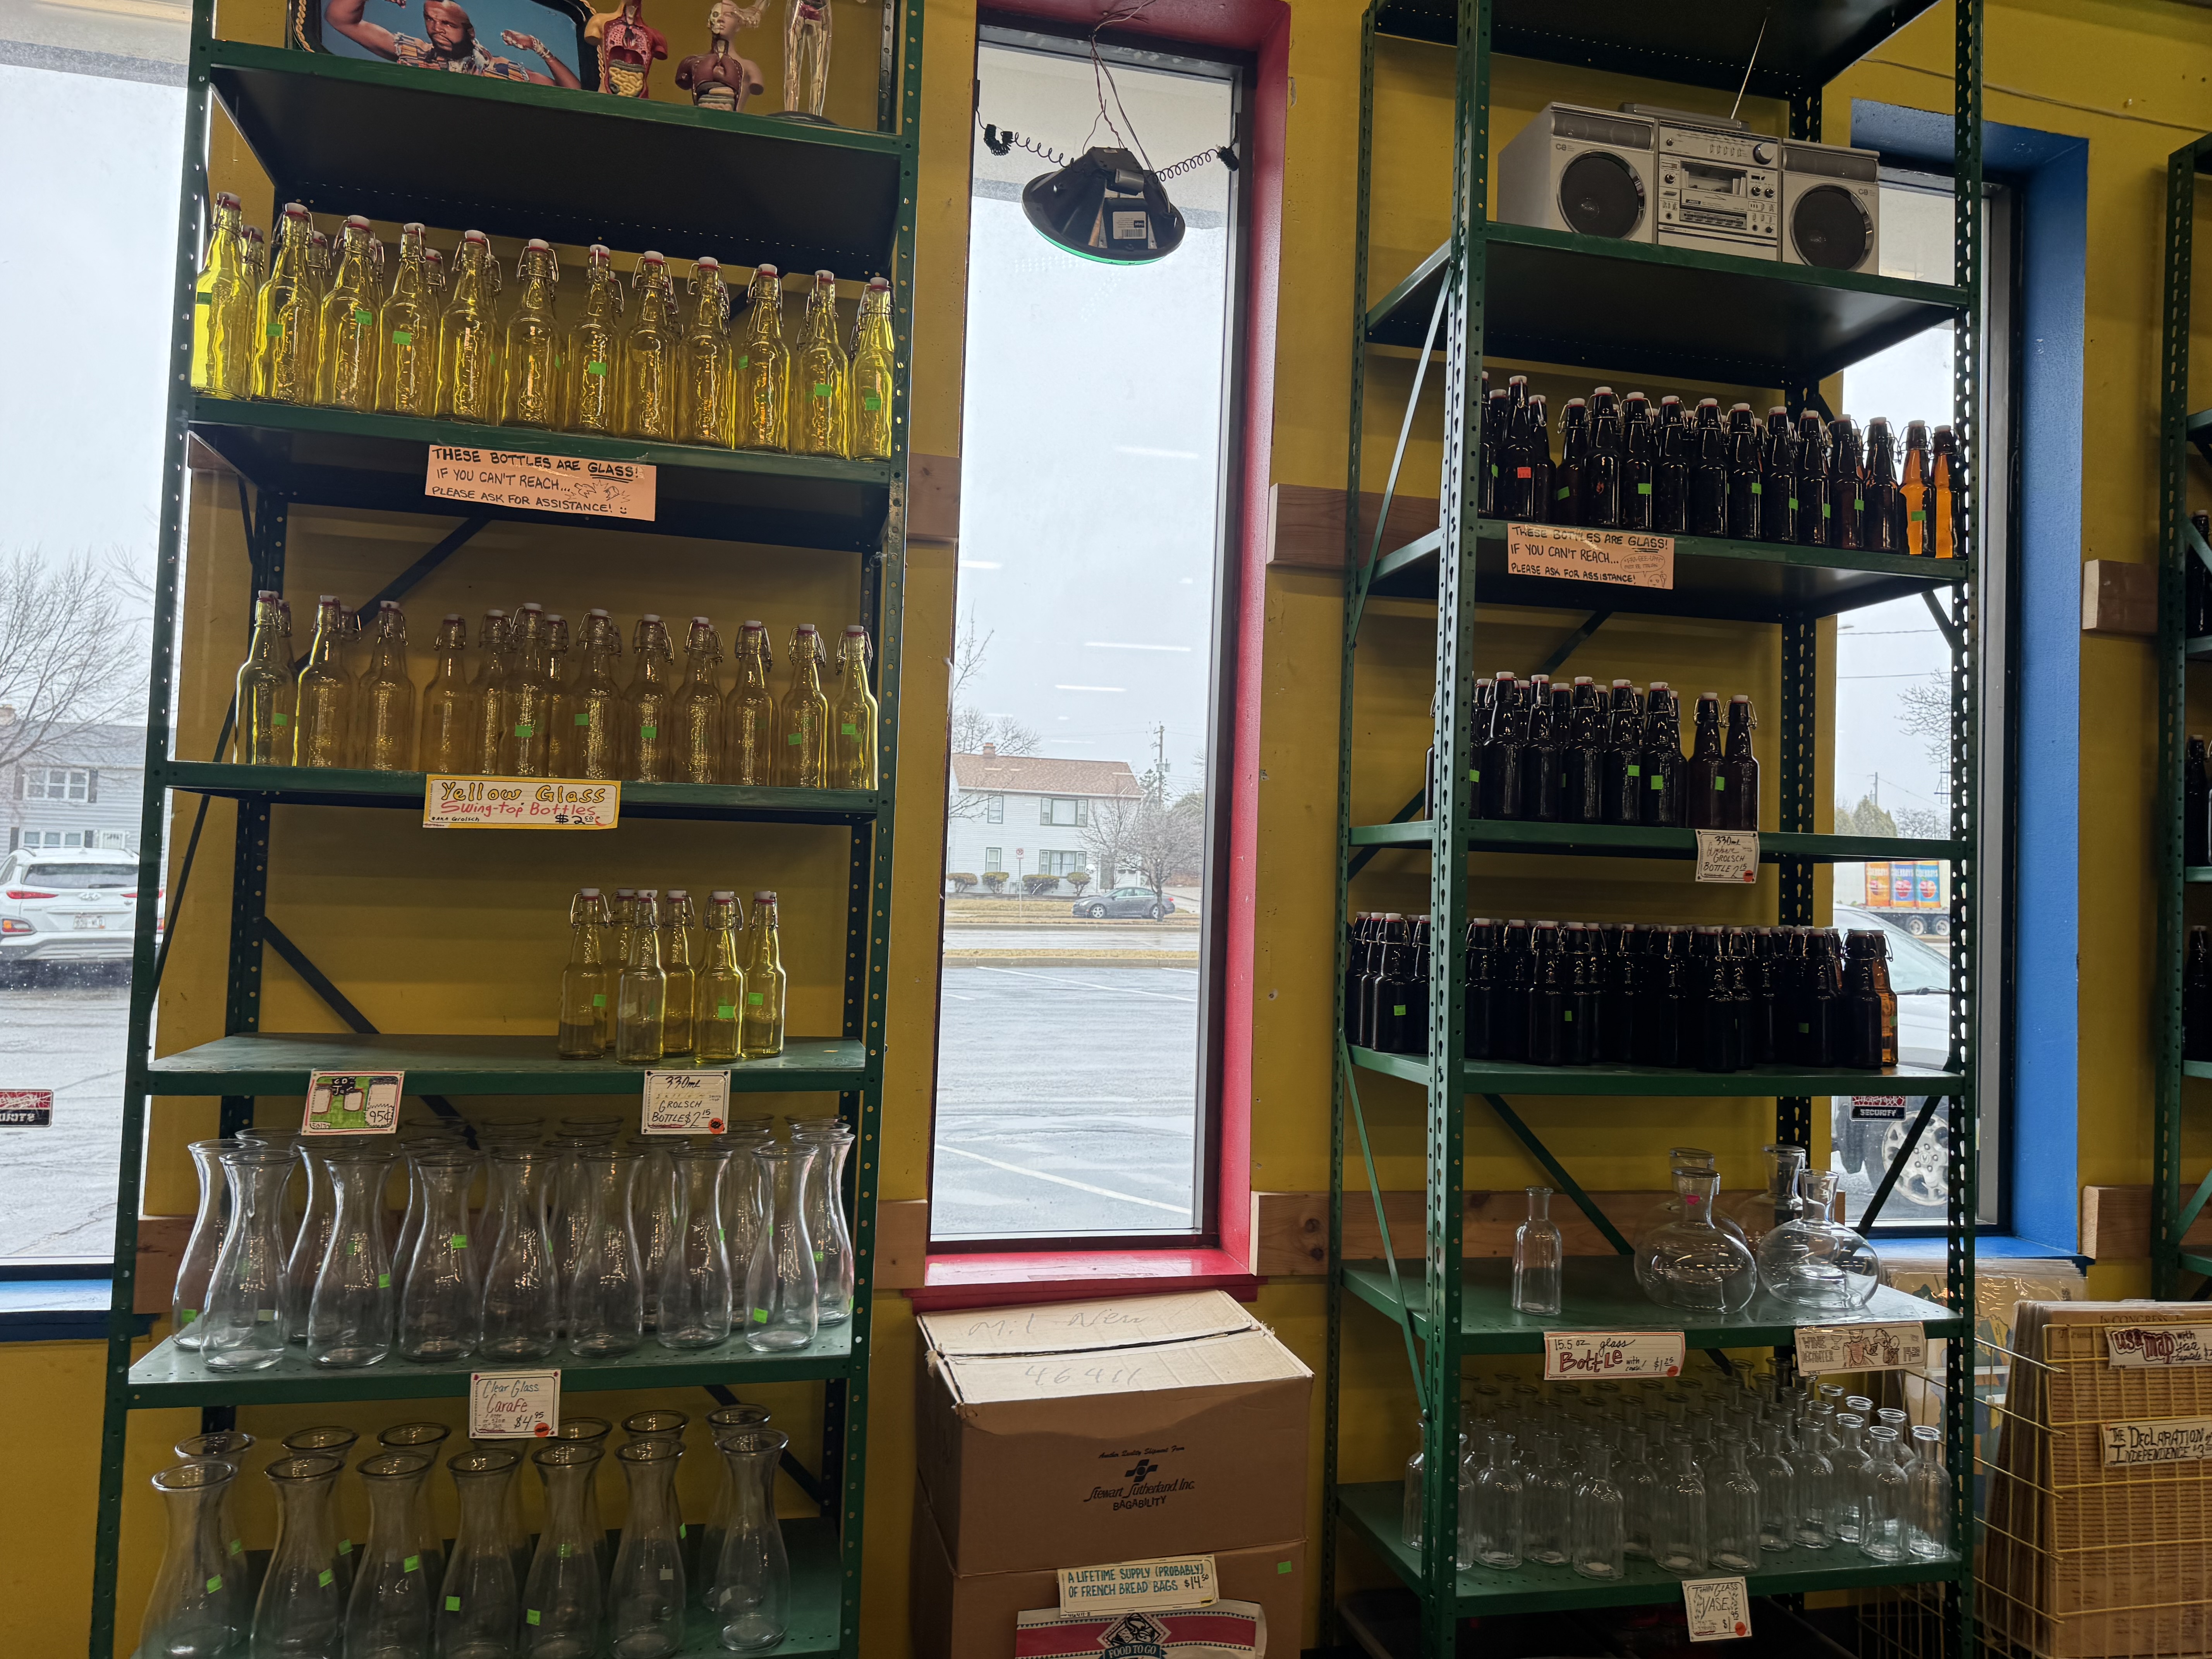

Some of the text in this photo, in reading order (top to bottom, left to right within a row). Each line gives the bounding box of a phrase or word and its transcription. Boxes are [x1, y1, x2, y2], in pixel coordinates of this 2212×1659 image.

[432, 448, 639, 478] THESE BOTTLES ARE GLASS!
[437, 467, 571, 493] IF YOU CAN'T REACH...
[432, 487, 613, 513] PLEASE ASK FOR ASSISTANCE!
[1512, 527, 1668, 550] THESE BOTTLES ARE GLASS!
[1511, 544, 1619, 564] IF YOU CAN'T REACH...
[1511, 563, 1636, 584] PLEASE ASK FOR ASSISTANCE!
[441, 782, 522, 801] Yellow
[536, 785, 606, 803] Glass
[530, 802, 596, 816] Bottles
[1704, 862, 1731, 872] BOTTLE
[1713, 854, 1745, 863] GROLSCH
[370, 1109, 393, 1122] 95¢
[659, 1100, 702, 1113] GROLSCH
[652, 1112, 685, 1122] BOTTLE
[1555, 1339, 1572, 1350] 15.5
[1600, 1338, 1635, 1357] glass
[483, 1380, 539, 1398] Clear Glass
[2110, 1428, 2126, 1442] THE
[1083, 1486, 1124, 1503] Stewart
[1113, 1496, 1166, 1511] BAGABILITY
[1068, 1563, 1203, 1583] A LIFETIME SUPPLY (PROBABLY)
[1069, 1586, 1078, 1598] OF
[1082, 1583, 1116, 1597] FRENCH
[1119, 1582, 1148, 1594] BREAD
[1153, 1580, 1178, 1593] BAGS
[1714, 1583, 1738, 1597] GLASS
[1701, 1597, 1729, 1620] VASE
[1108, 1645, 1157, 1659] FOOD TO GO
